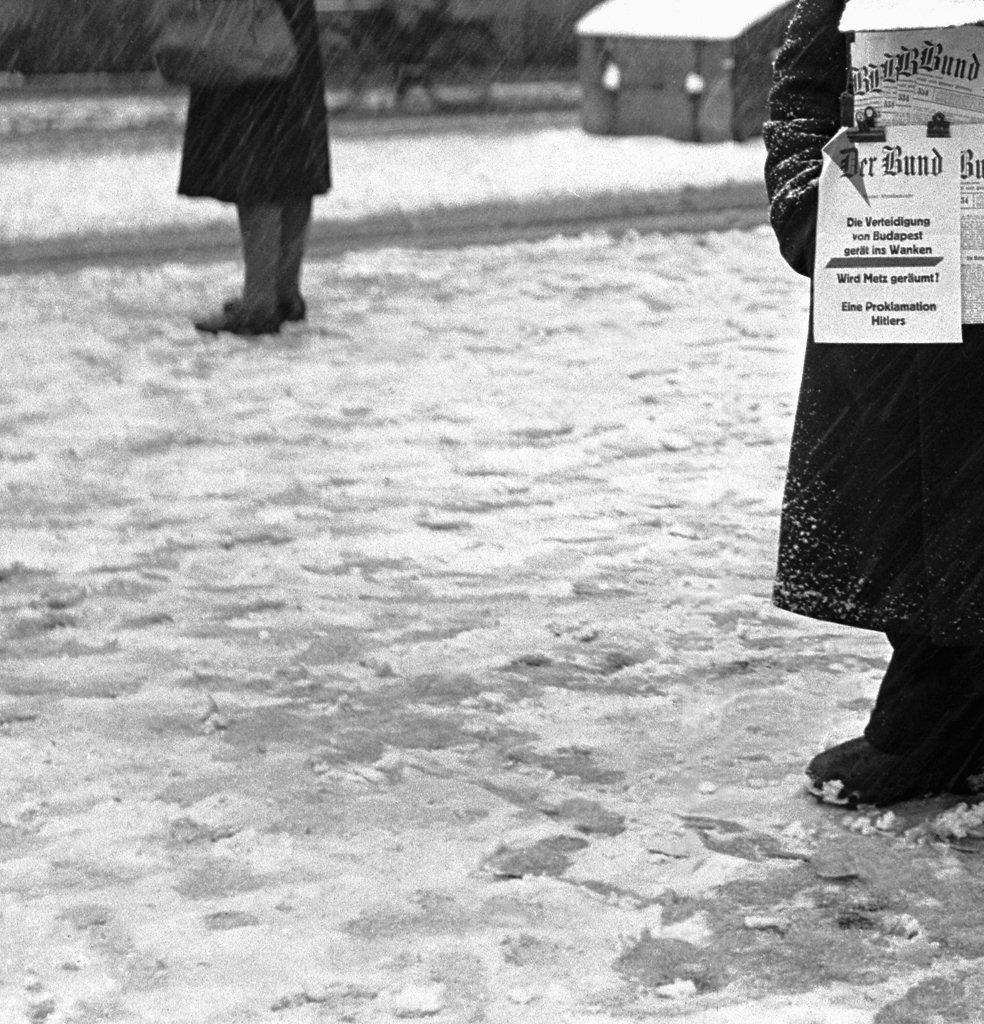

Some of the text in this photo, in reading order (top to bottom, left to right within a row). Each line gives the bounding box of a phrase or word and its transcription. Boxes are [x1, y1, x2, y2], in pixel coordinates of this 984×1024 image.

[839, 145, 943, 178] Der Bund
[846, 217, 930, 227] Die Verteidigung
[852, 231, 923, 242] von Budapest
[844, 244, 932, 256] gerät ins Wanken
[837, 272, 940, 284] Wird Metz geräumt?
[841, 301, 937, 312] Eine Proklamation
[871, 315, 906, 326] Hitlers
